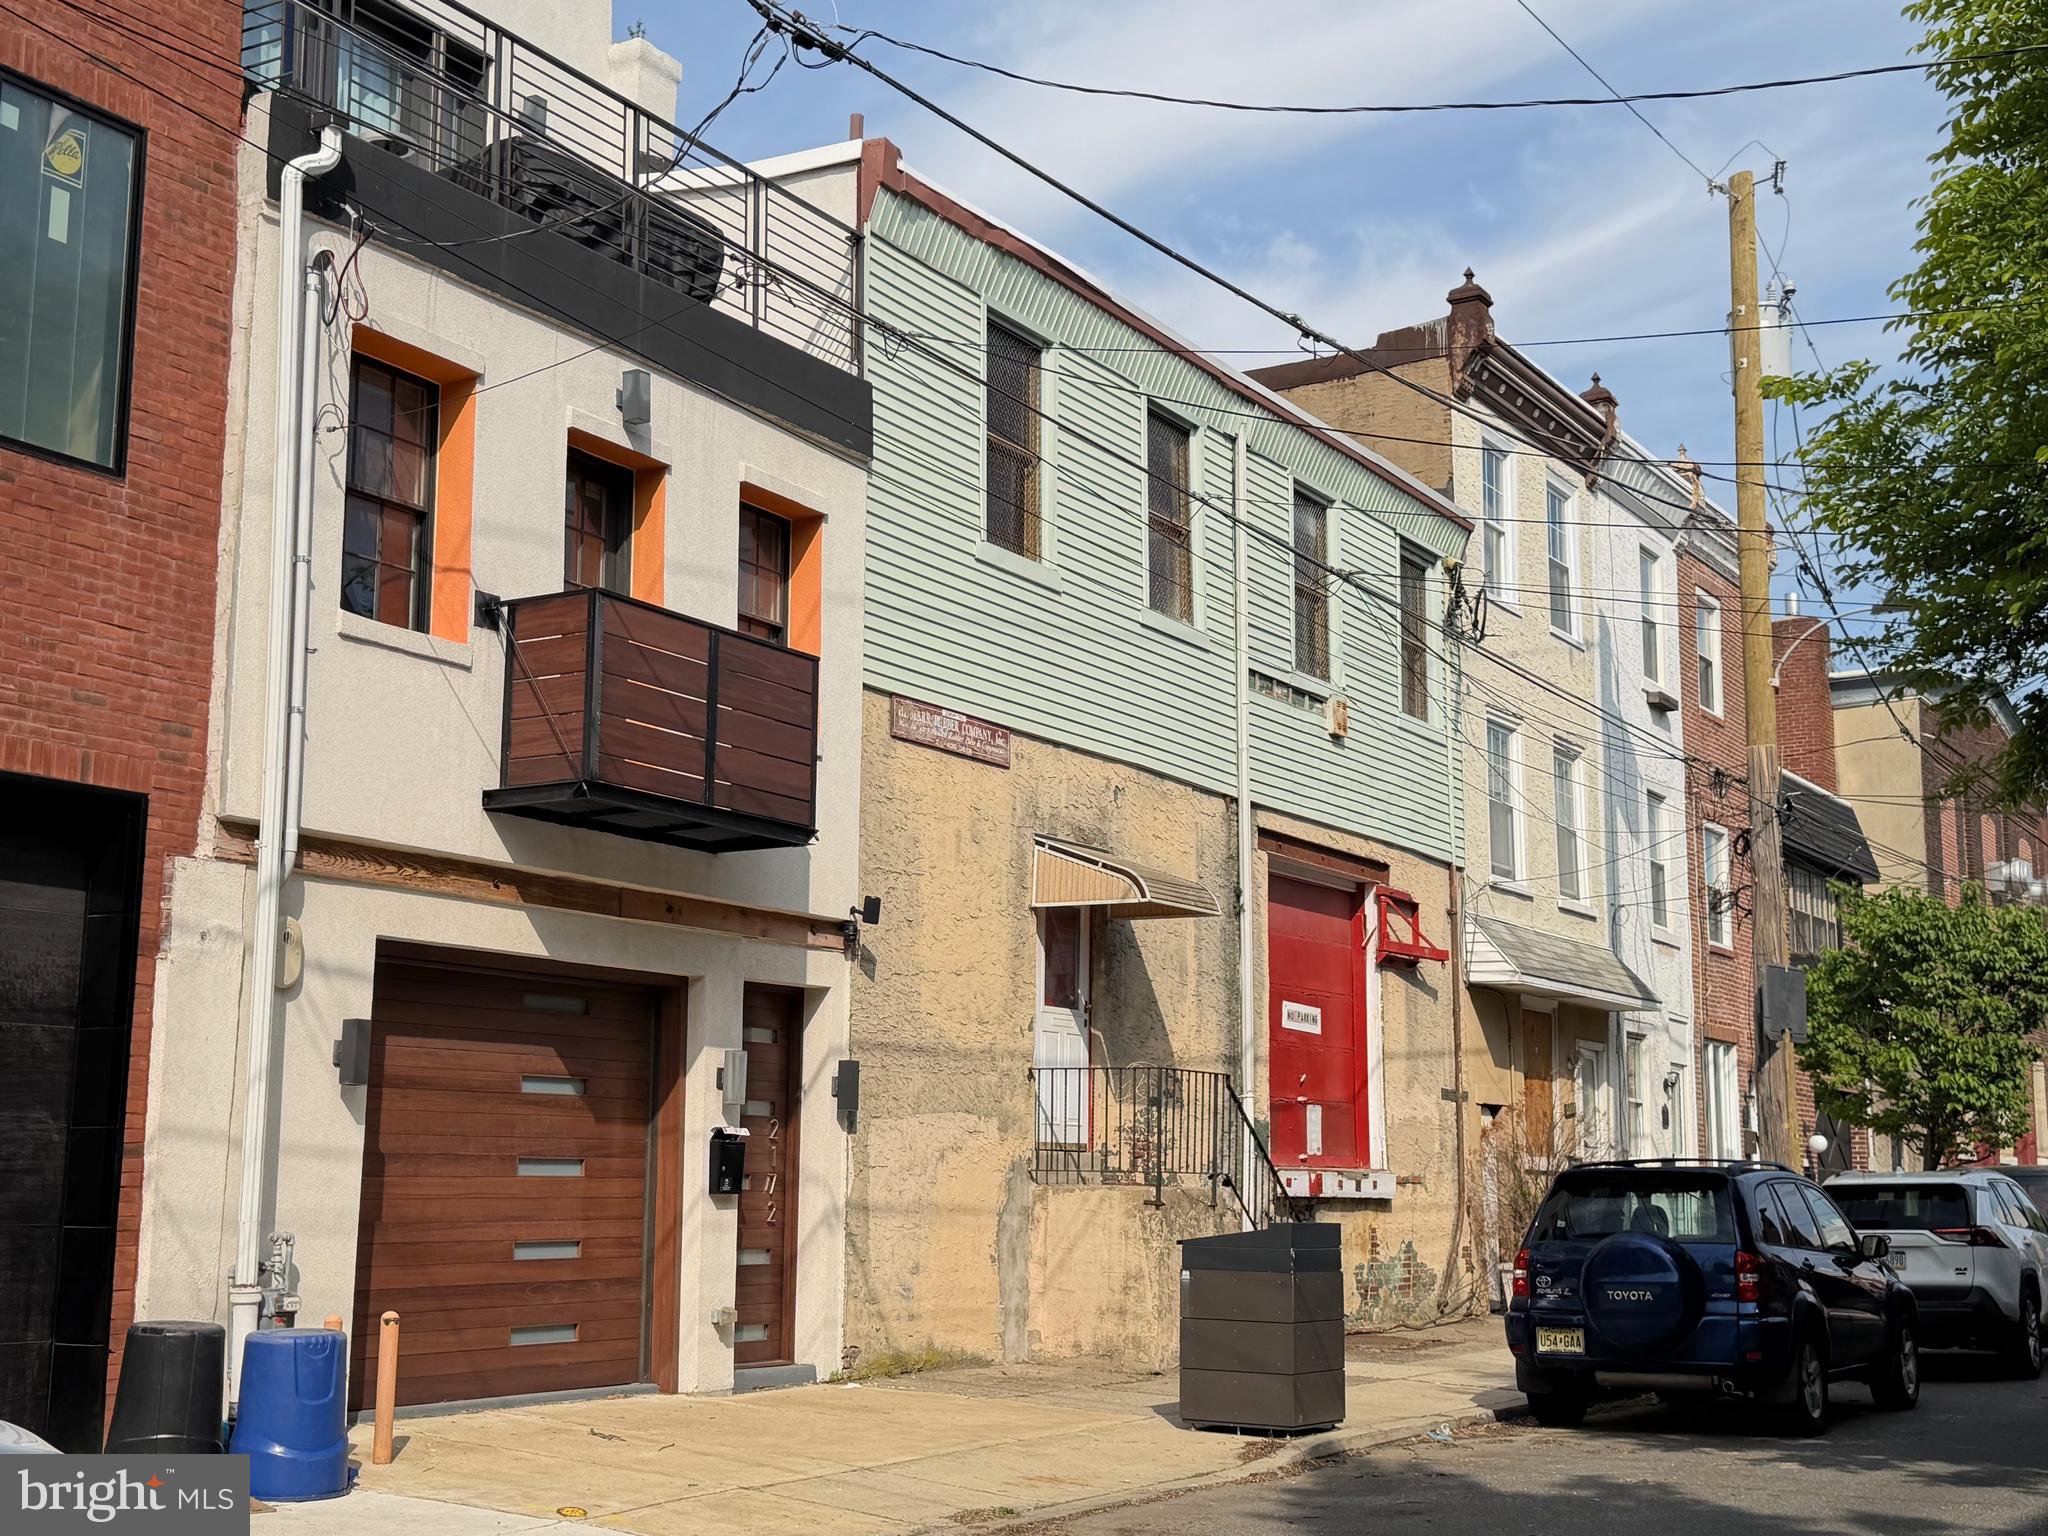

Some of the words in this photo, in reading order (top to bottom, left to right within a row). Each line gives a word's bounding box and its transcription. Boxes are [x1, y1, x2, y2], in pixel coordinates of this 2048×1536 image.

[1287, 1008, 1294, 1020] NO
[1297, 1010, 1318, 1024] PARKING
[766, 1118, 779, 1222] 2172
[1607, 1290, 1653, 1300] TOYOTA
